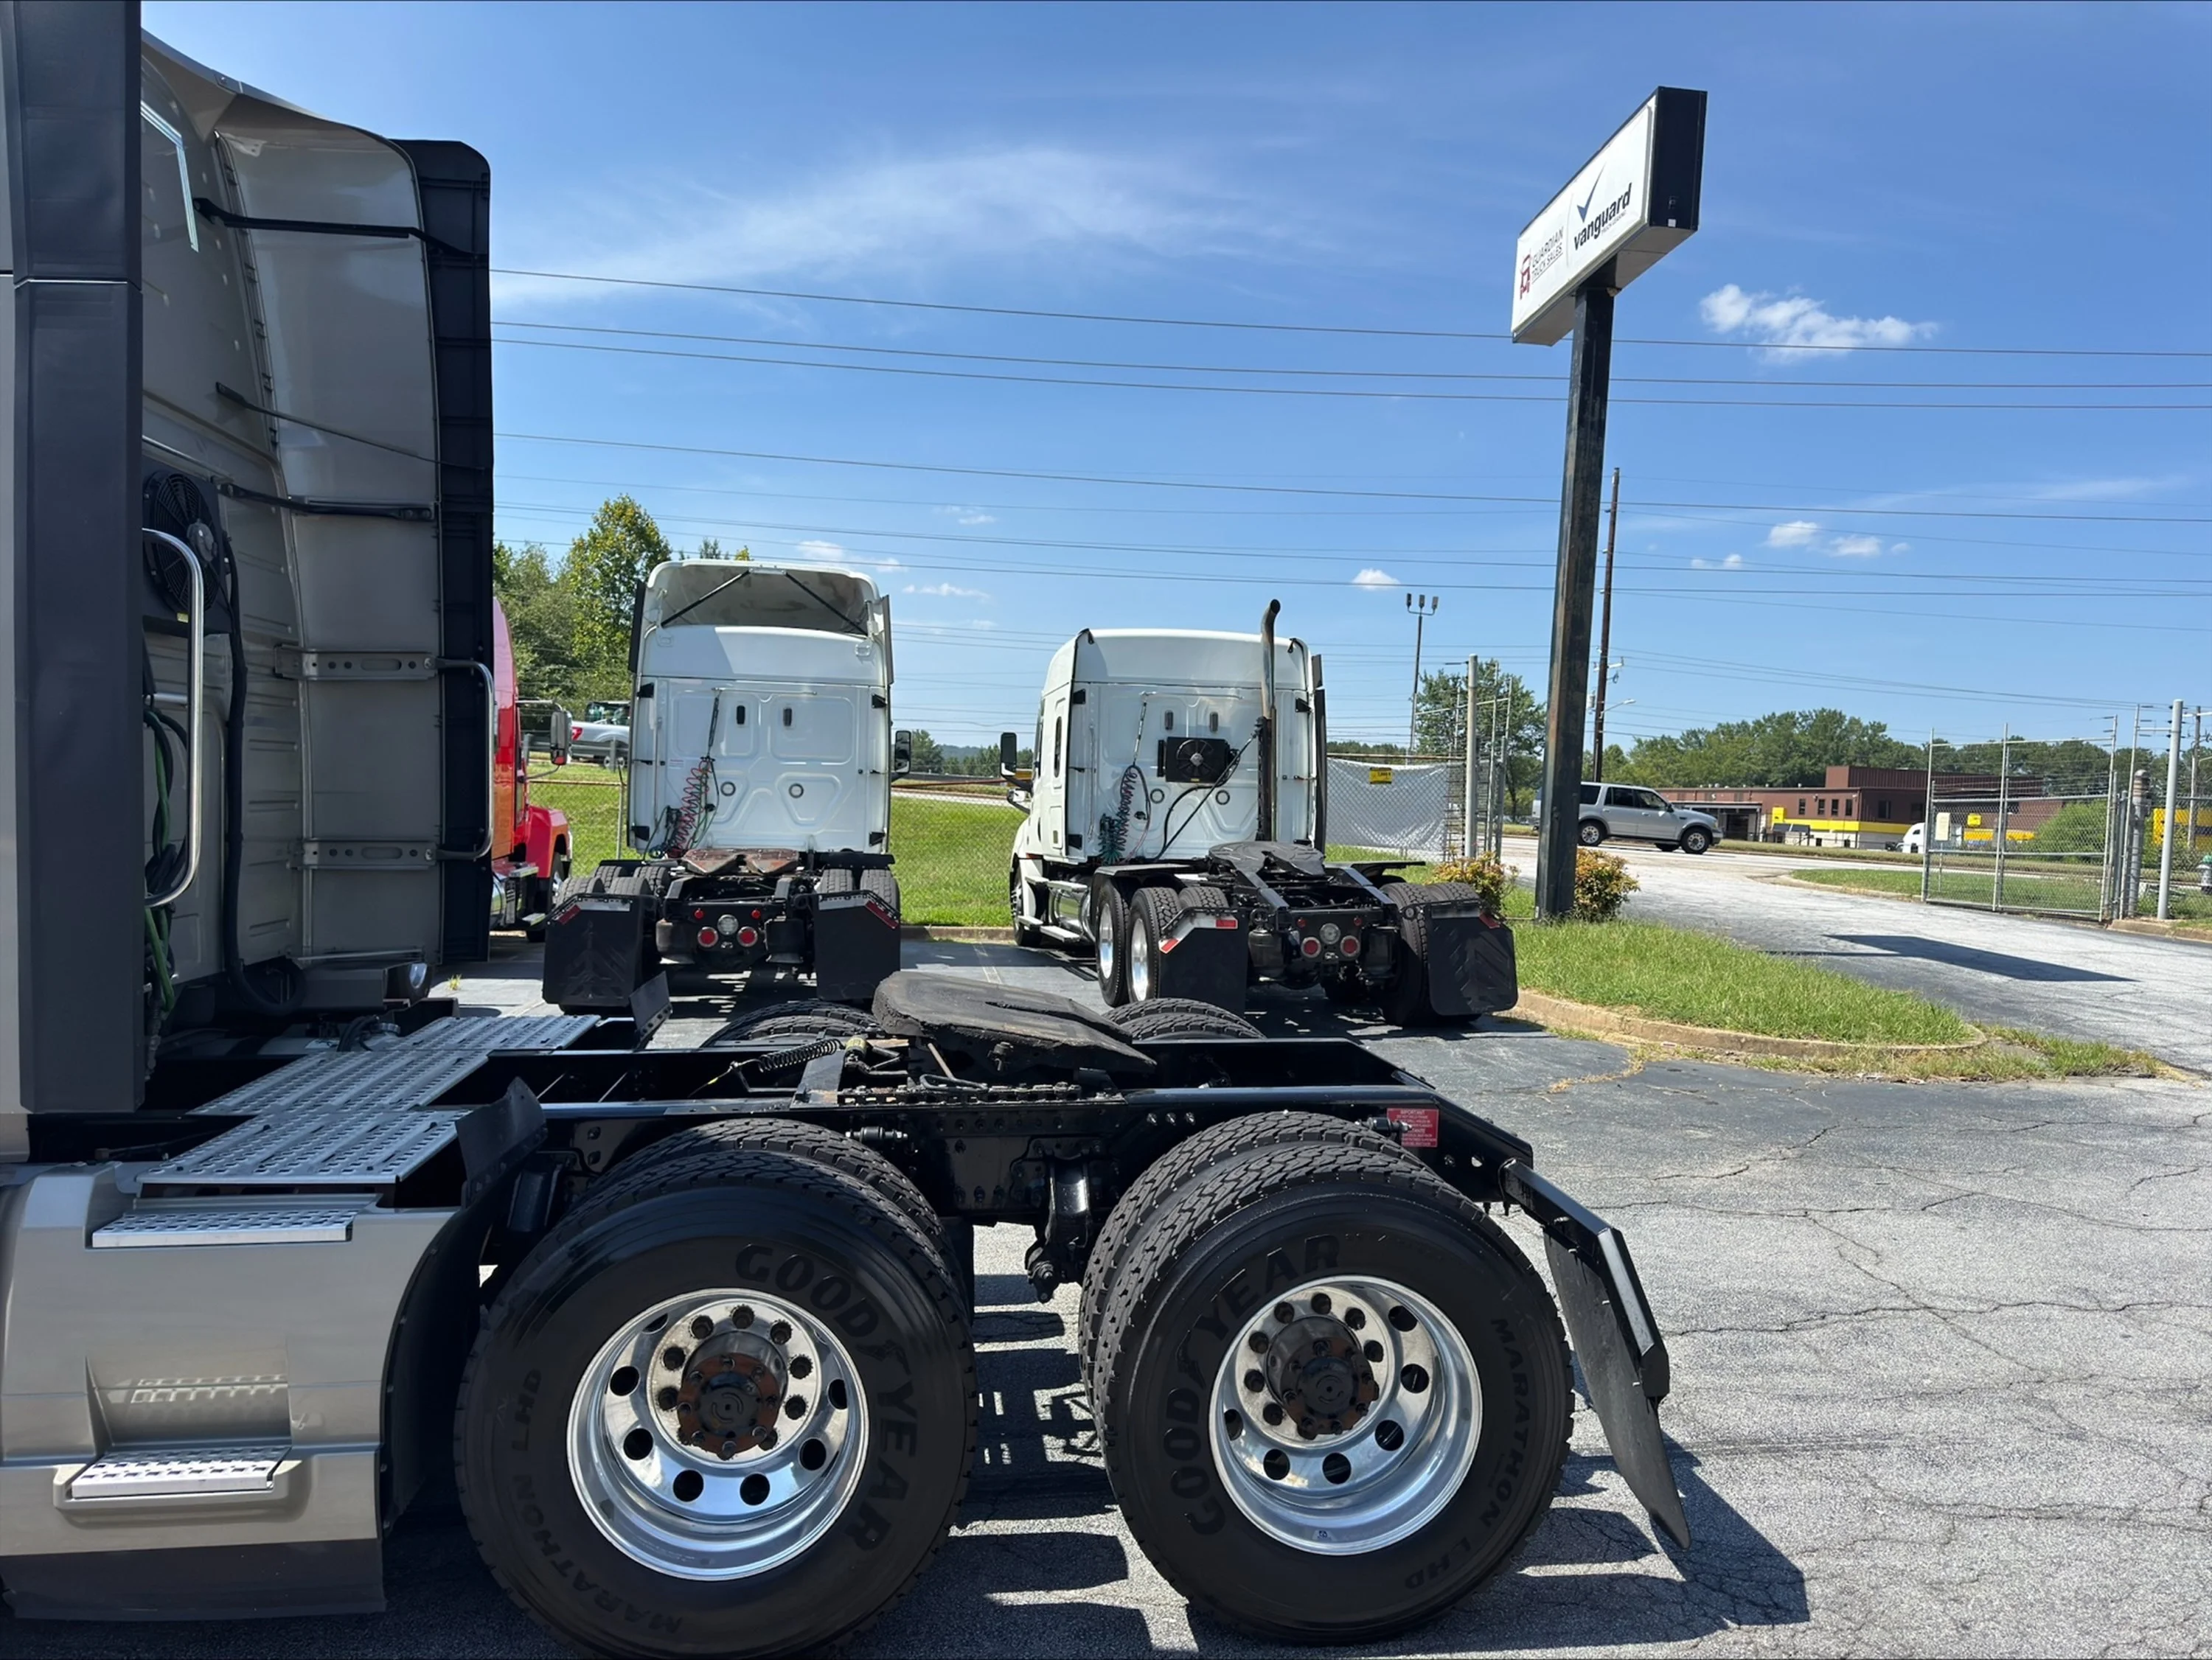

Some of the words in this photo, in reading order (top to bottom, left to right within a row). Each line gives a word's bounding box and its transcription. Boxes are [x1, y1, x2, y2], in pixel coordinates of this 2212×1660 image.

[1532, 225, 1565, 268] GUARDIAN
[1573, 182, 1632, 251] vanguard
[1531, 259, 1546, 281] TRUCK
[1546, 242, 1563, 265] SALES
[512, 1368, 542, 1452] LHD
[1481, 1318, 1531, 1528] MARATHON
[512, 1474, 683, 1634] MARATHON
[1405, 1536, 1472, 1590] LHD
